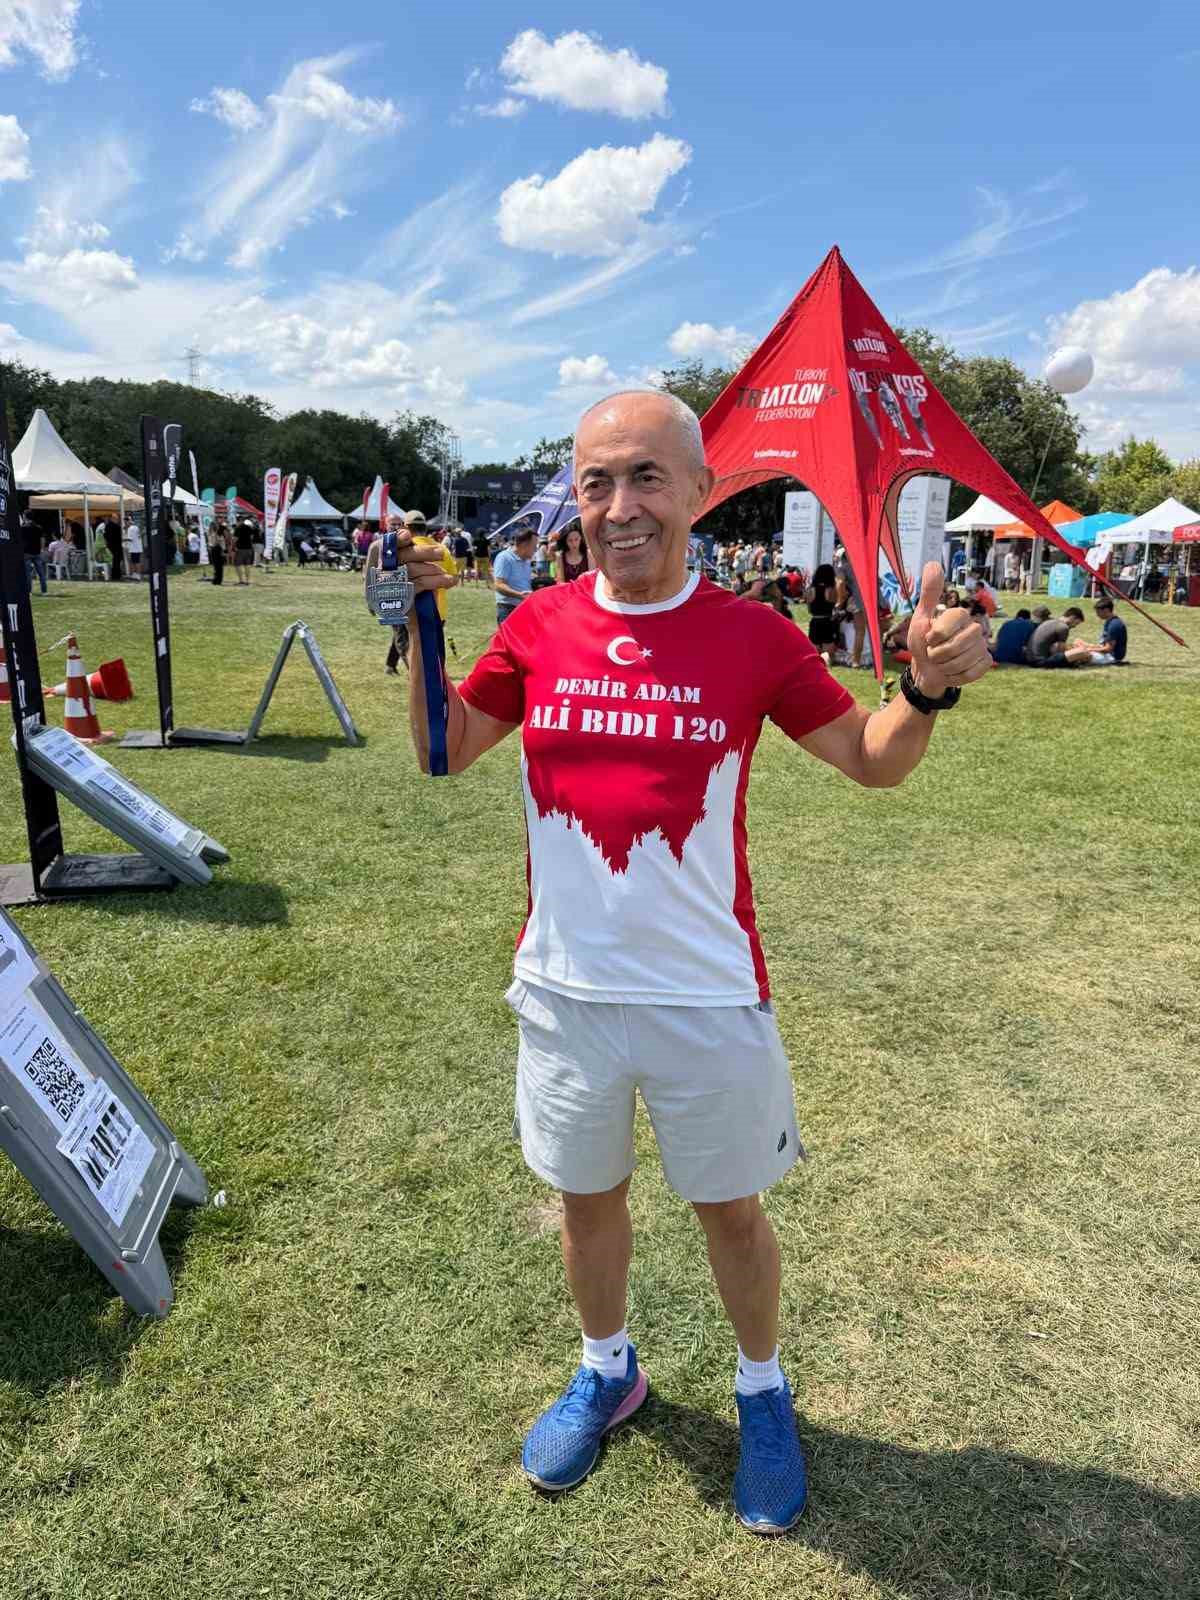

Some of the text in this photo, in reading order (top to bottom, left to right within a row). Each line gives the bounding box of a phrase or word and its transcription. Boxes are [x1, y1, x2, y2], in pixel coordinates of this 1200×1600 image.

[554, 675, 701, 704] DEMİR ADAM
[529, 699, 727, 743] ALİ BIDI 120
